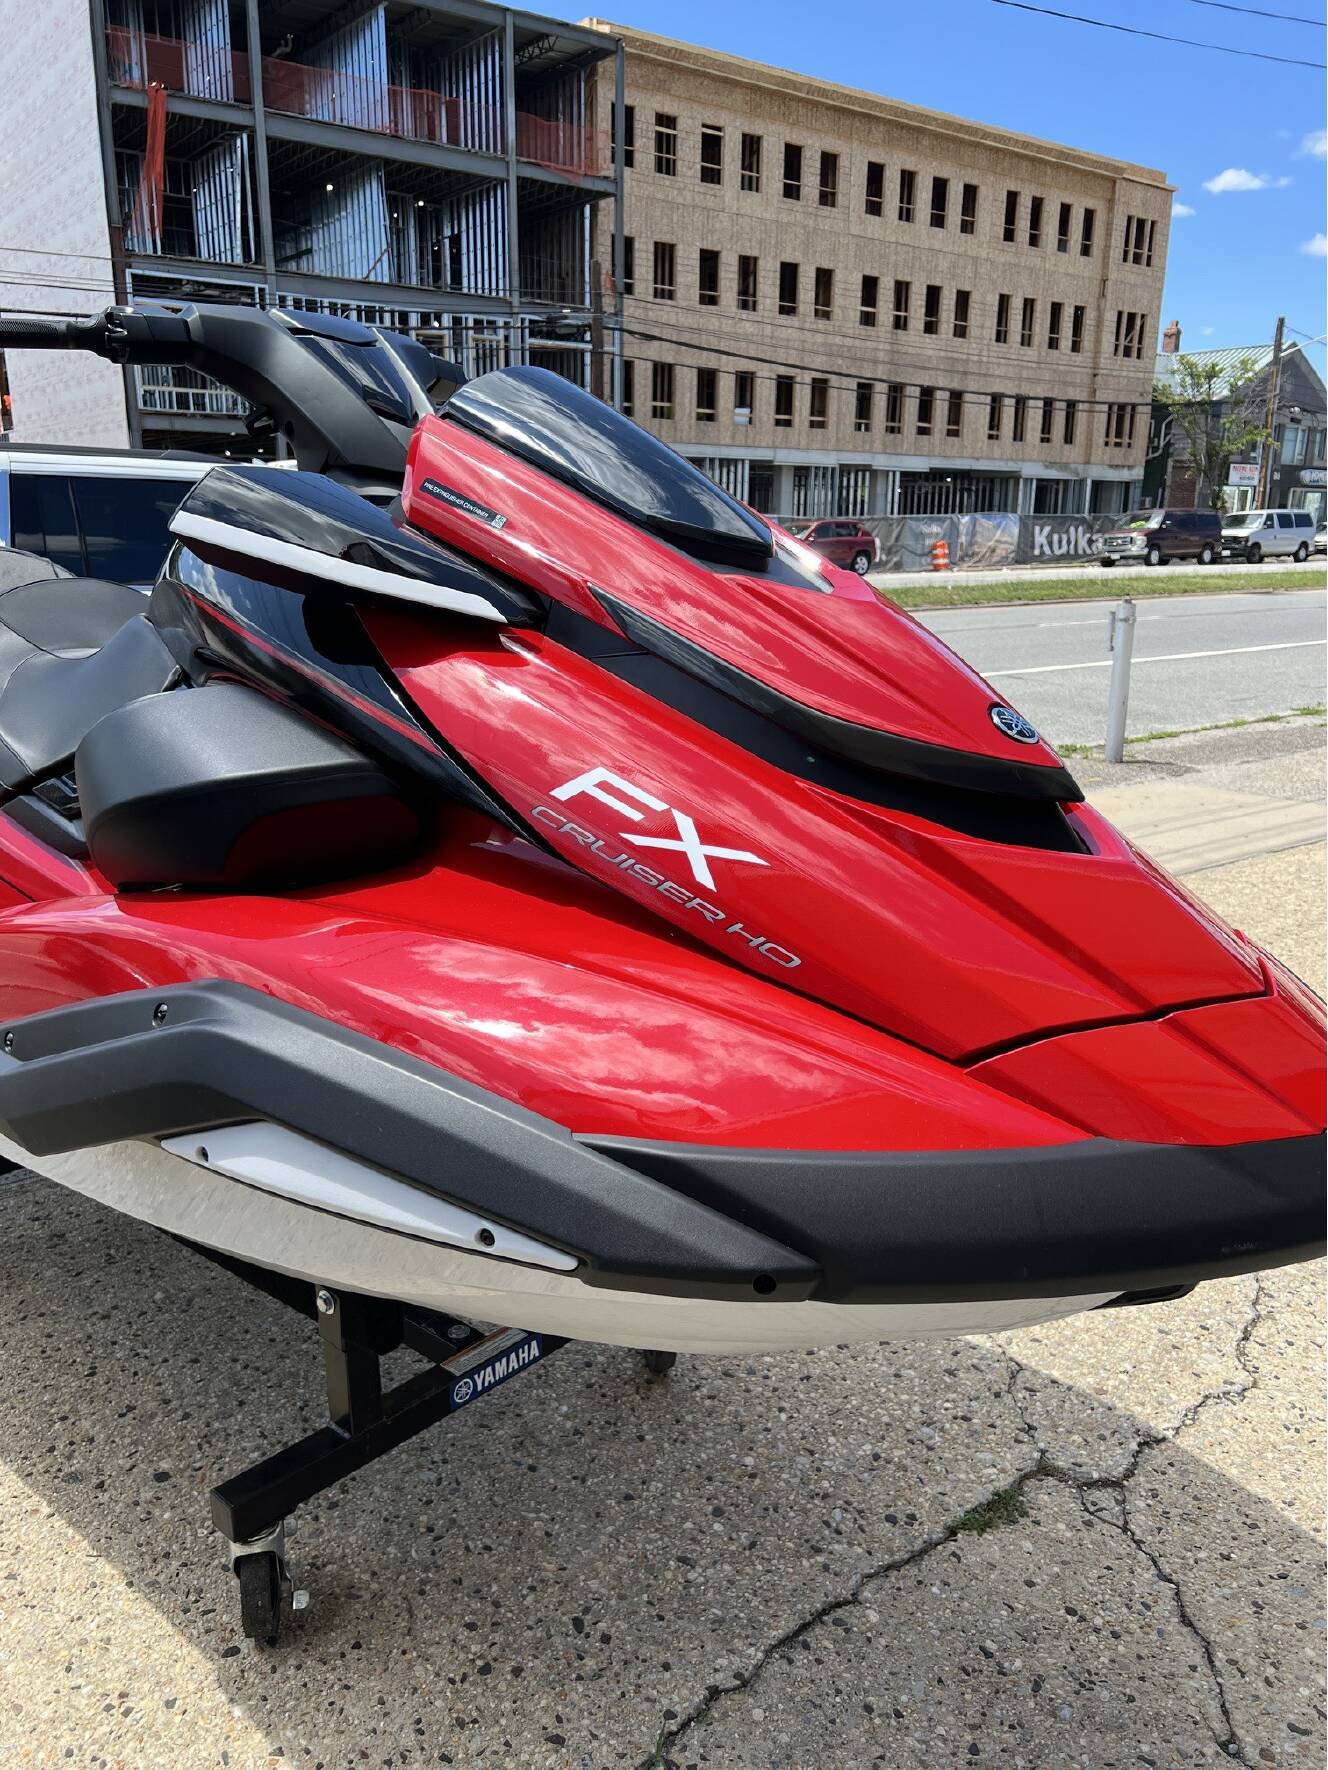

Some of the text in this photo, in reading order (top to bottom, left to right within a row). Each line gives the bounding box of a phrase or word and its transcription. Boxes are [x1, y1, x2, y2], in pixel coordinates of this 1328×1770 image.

[423, 481, 489, 518] FIRE EXTINGUISHER CONTAINER
[1033, 525, 1104, 556] Kulka
[549, 766, 772, 893] FX
[531, 805, 802, 969] CRUISER HO
[473, 1340, 540, 1392] YAMAHA
